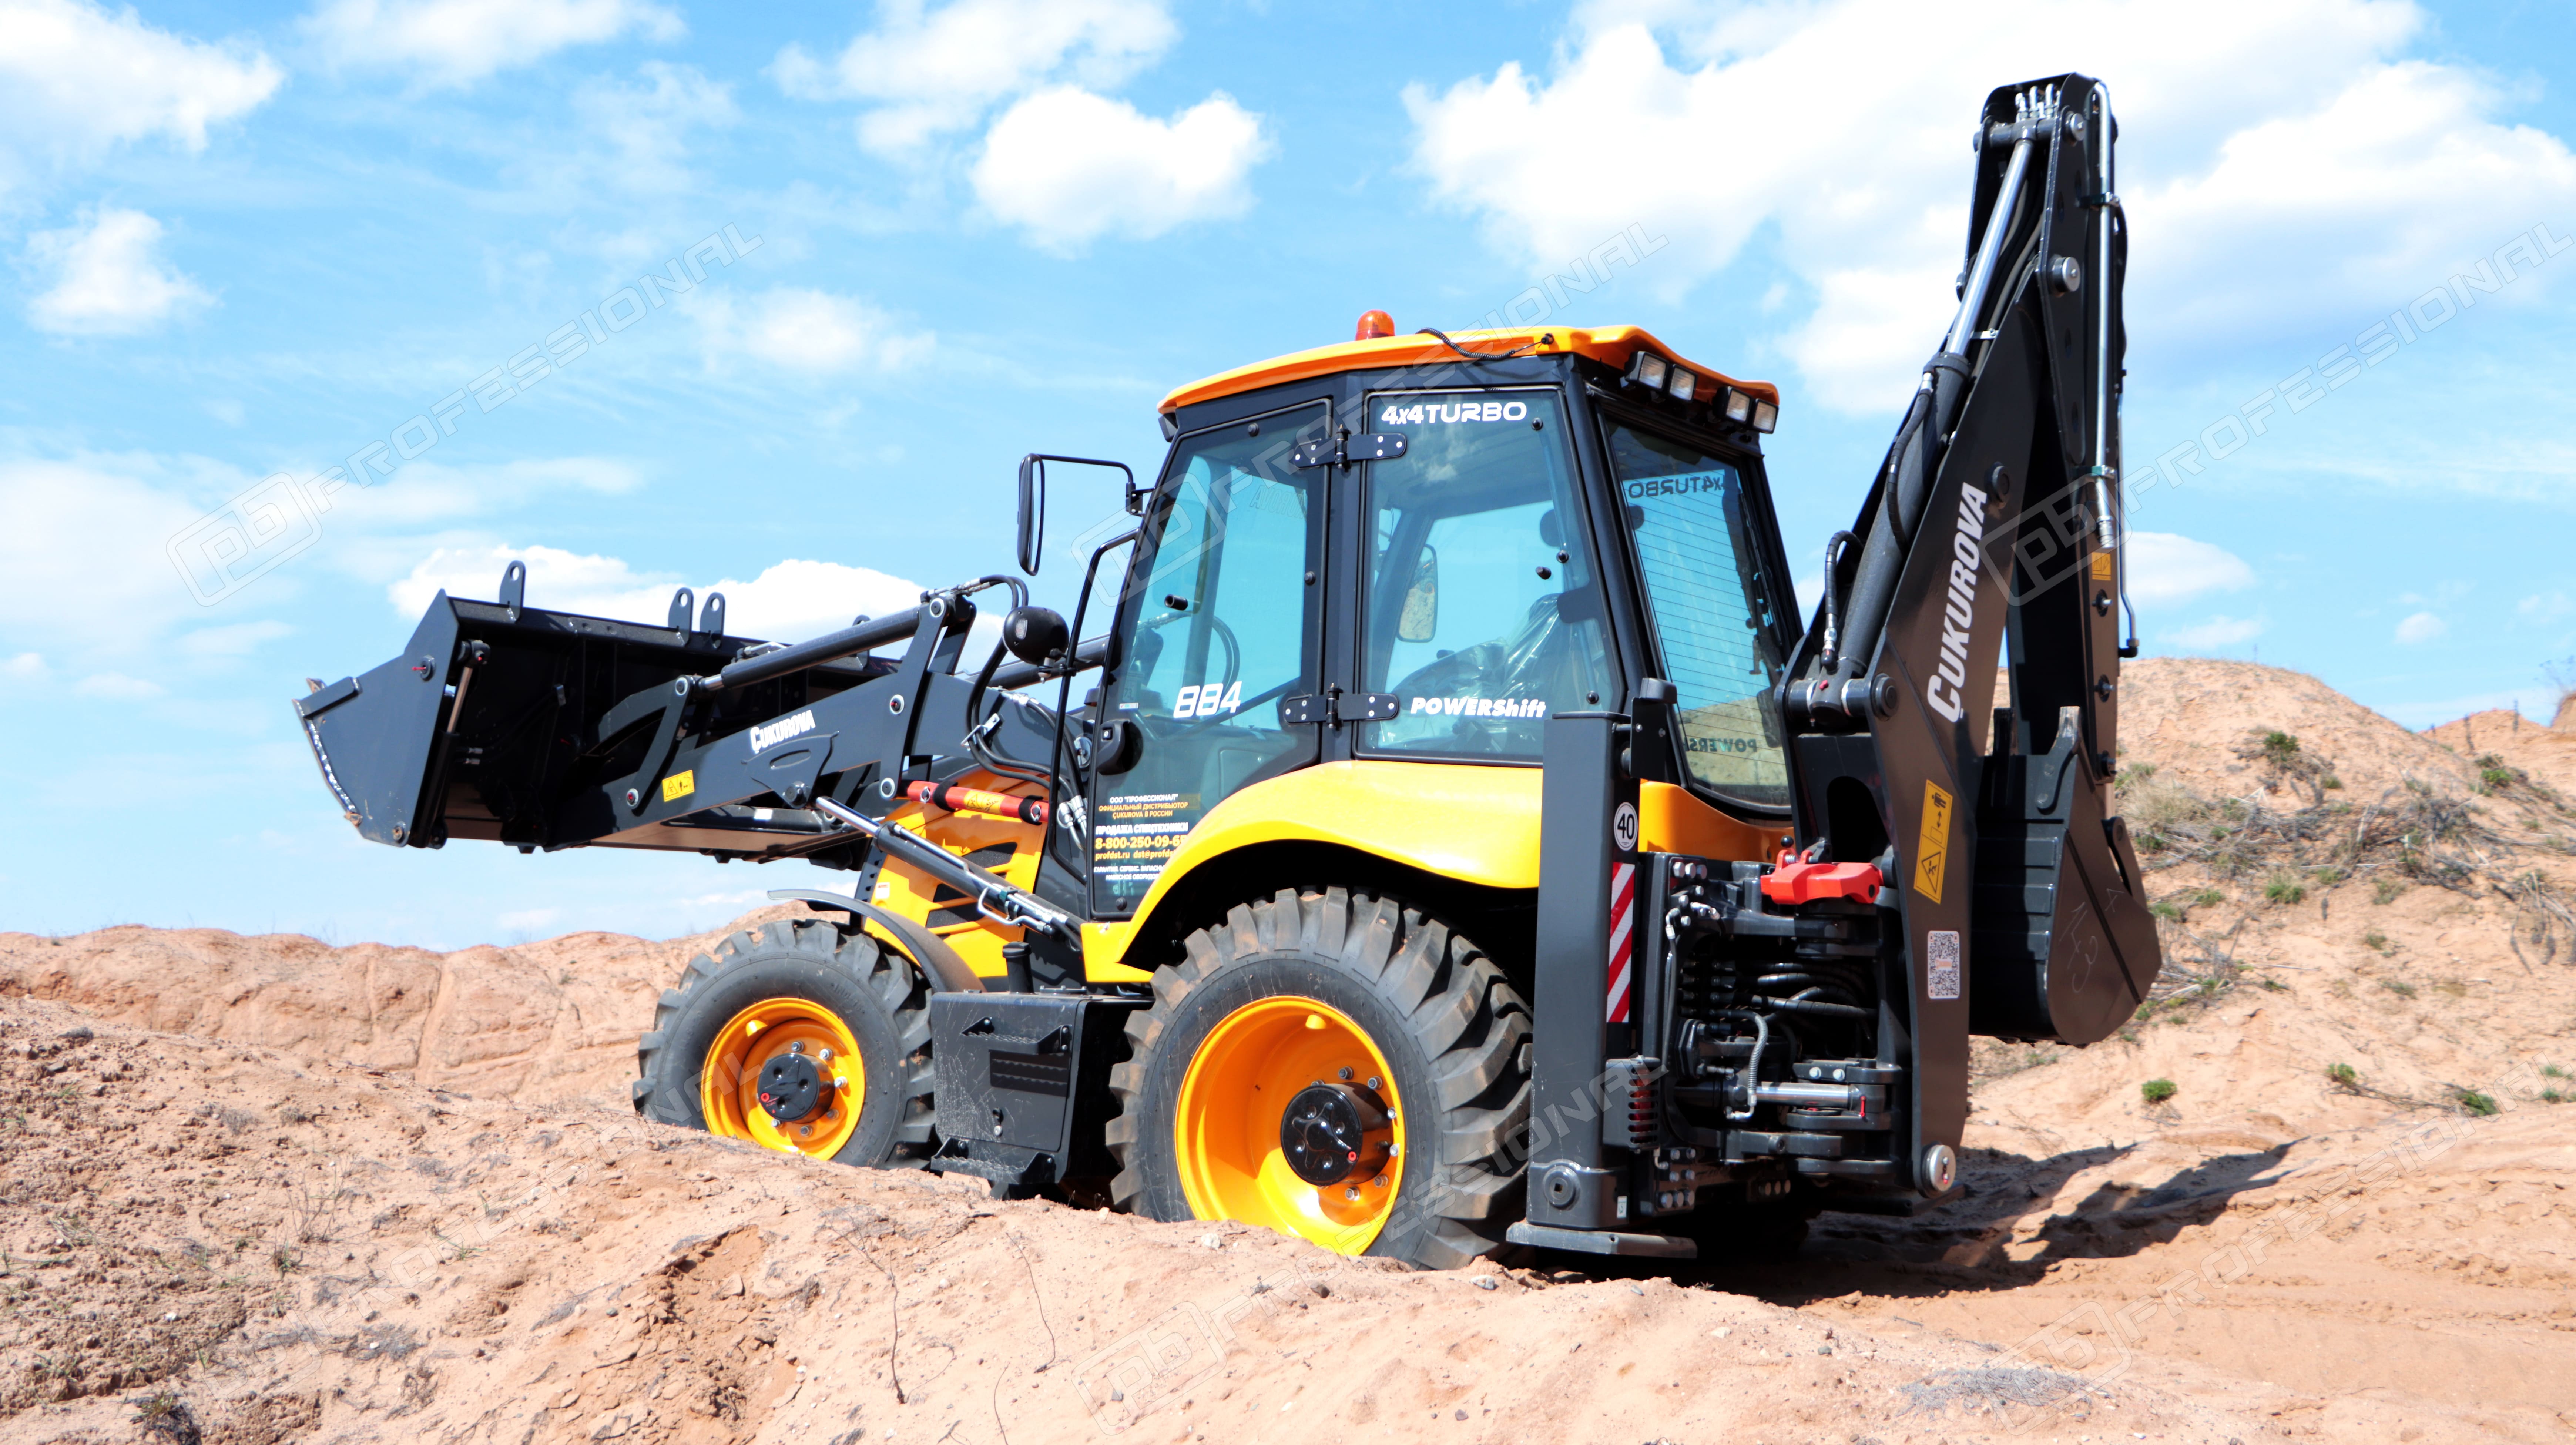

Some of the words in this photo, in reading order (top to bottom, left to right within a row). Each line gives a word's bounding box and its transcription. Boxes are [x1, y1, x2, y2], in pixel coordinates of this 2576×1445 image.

[1410, 697, 1546, 718] POWERShift
[1124, 794, 1178, 803] "ПРОФЕССИОНАЛ"
[1099, 803, 1142, 811] ОФИЦИАЛЬНЫЙ
[1143, 802, 1188, 811] ДИСТРИБЬЮТОР
[1113, 811, 1143, 819] ÇUKUROVA
[1096, 825, 1133, 835] ПРОДАЖА
[1134, 822, 1188, 834] СПЕЦТЕХНИКИ
[1617, 813, 1635, 839] 40
[1095, 851, 1130, 861] profdst.ru
[1133, 849, 1175, 859] dst@profds
